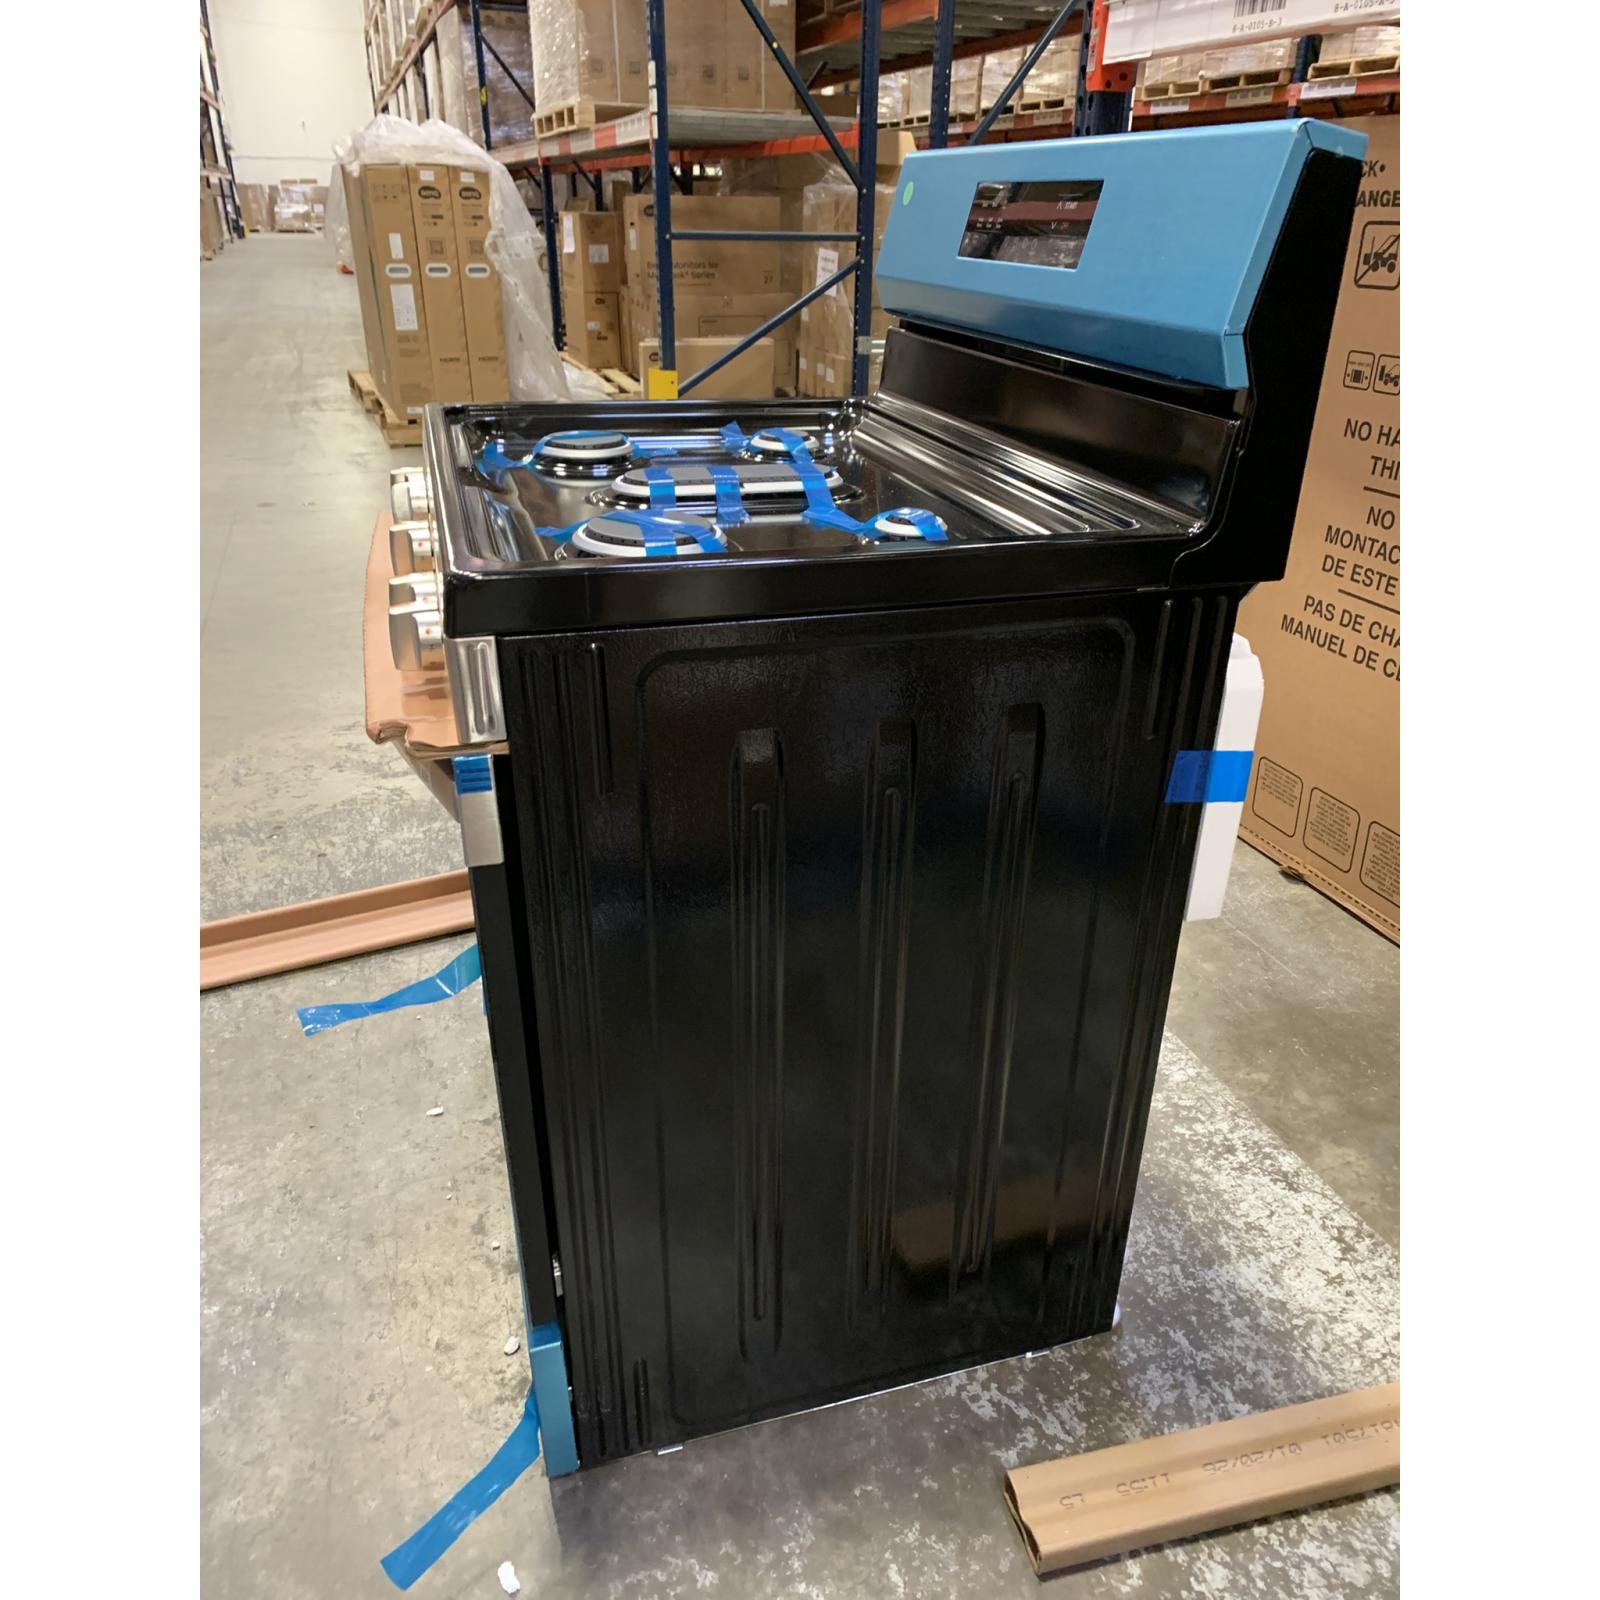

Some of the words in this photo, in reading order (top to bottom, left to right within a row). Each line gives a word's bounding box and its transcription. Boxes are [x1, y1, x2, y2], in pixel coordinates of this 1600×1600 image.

[1344, 418, 1372, 441] NO
[1366, 506, 1395, 530] NO
[1322, 554, 1347, 578] DE
[1350, 564, 1398, 596] ESTE
[1304, 595, 1336, 621] PAS
[1339, 609, 1365, 634] DE
[1281, 614, 1348, 658] MANUEL
[1353, 645, 1379, 671] DE
